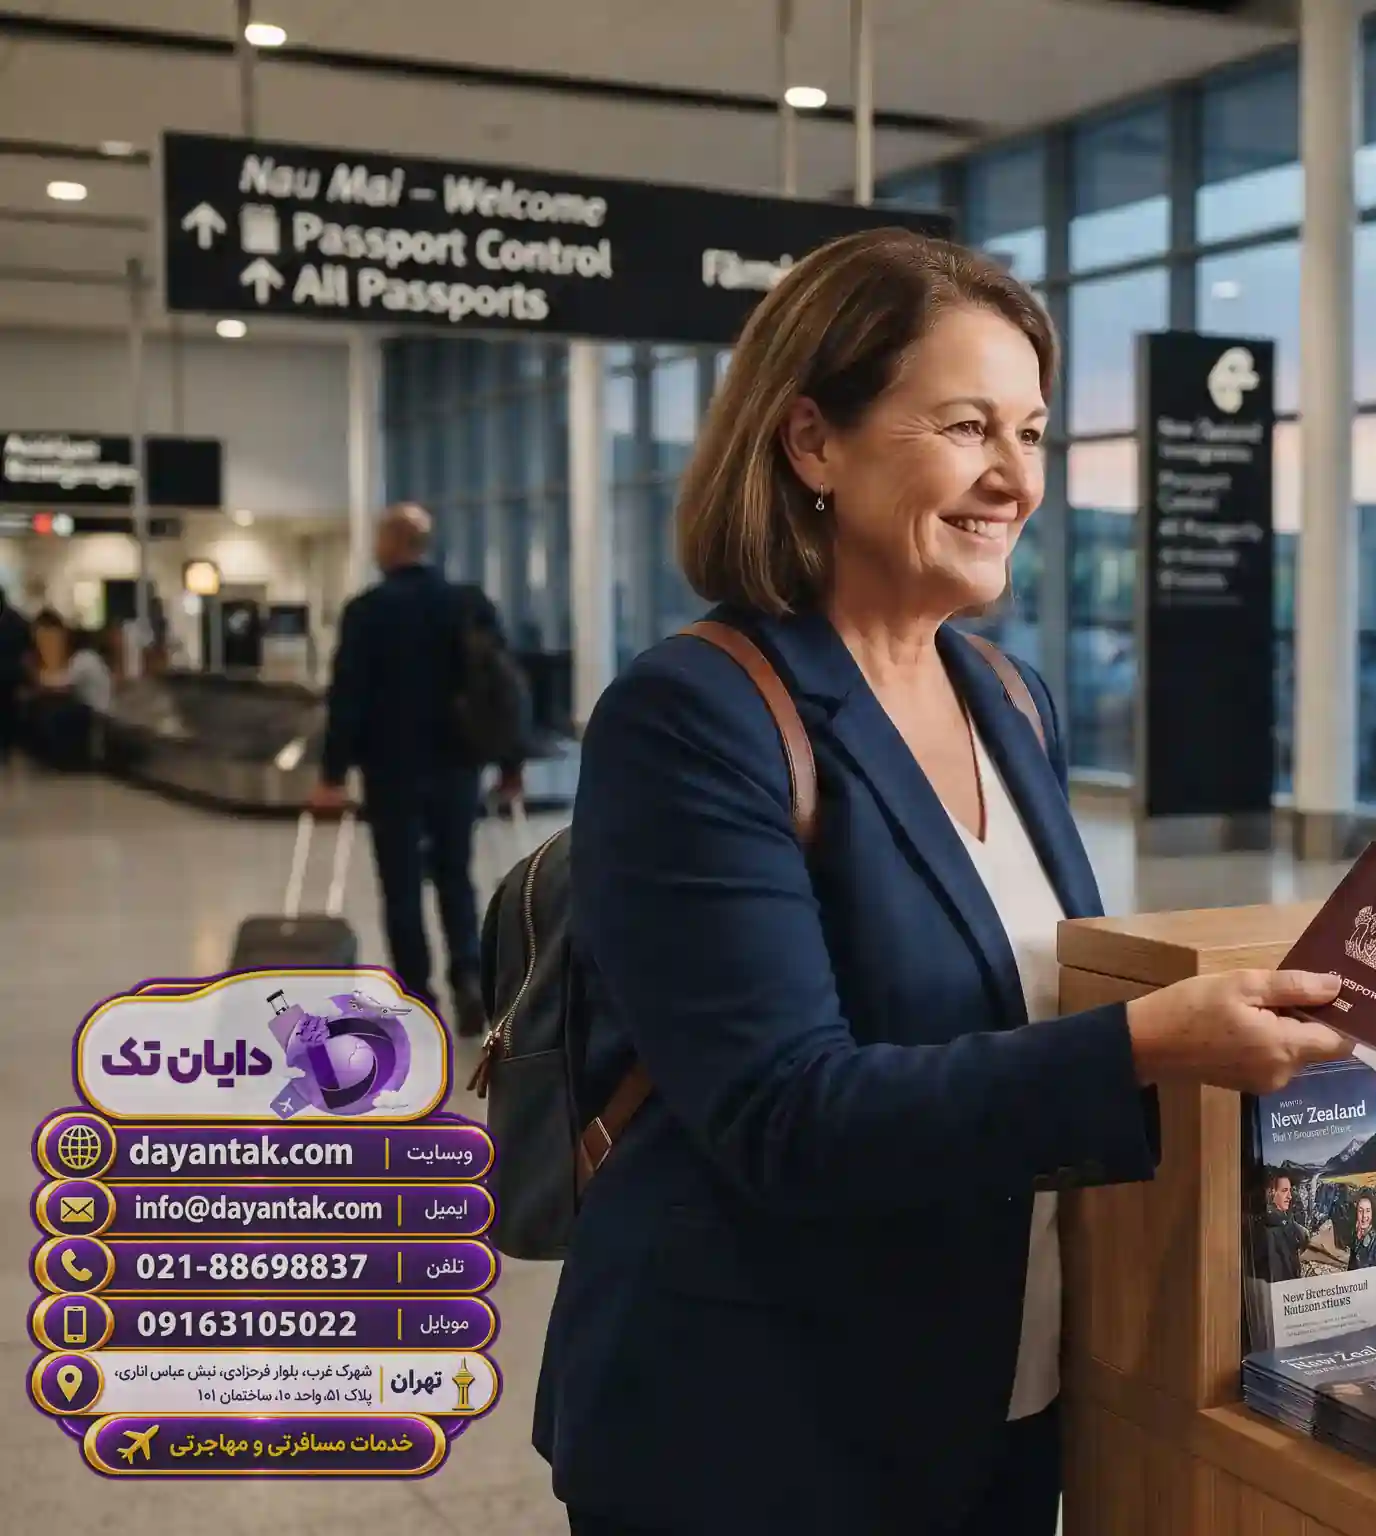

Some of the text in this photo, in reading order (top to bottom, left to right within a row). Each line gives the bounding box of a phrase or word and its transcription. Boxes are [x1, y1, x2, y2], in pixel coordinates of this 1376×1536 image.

[238, 153, 321, 199] Nau
[443, 173, 608, 228] Welcome
[292, 210, 613, 280] Passport Control
[292, 262, 550, 323] All Passports
[1270, 1112, 1304, 1129] New
[1306, 1099, 1366, 1124] Zealand
